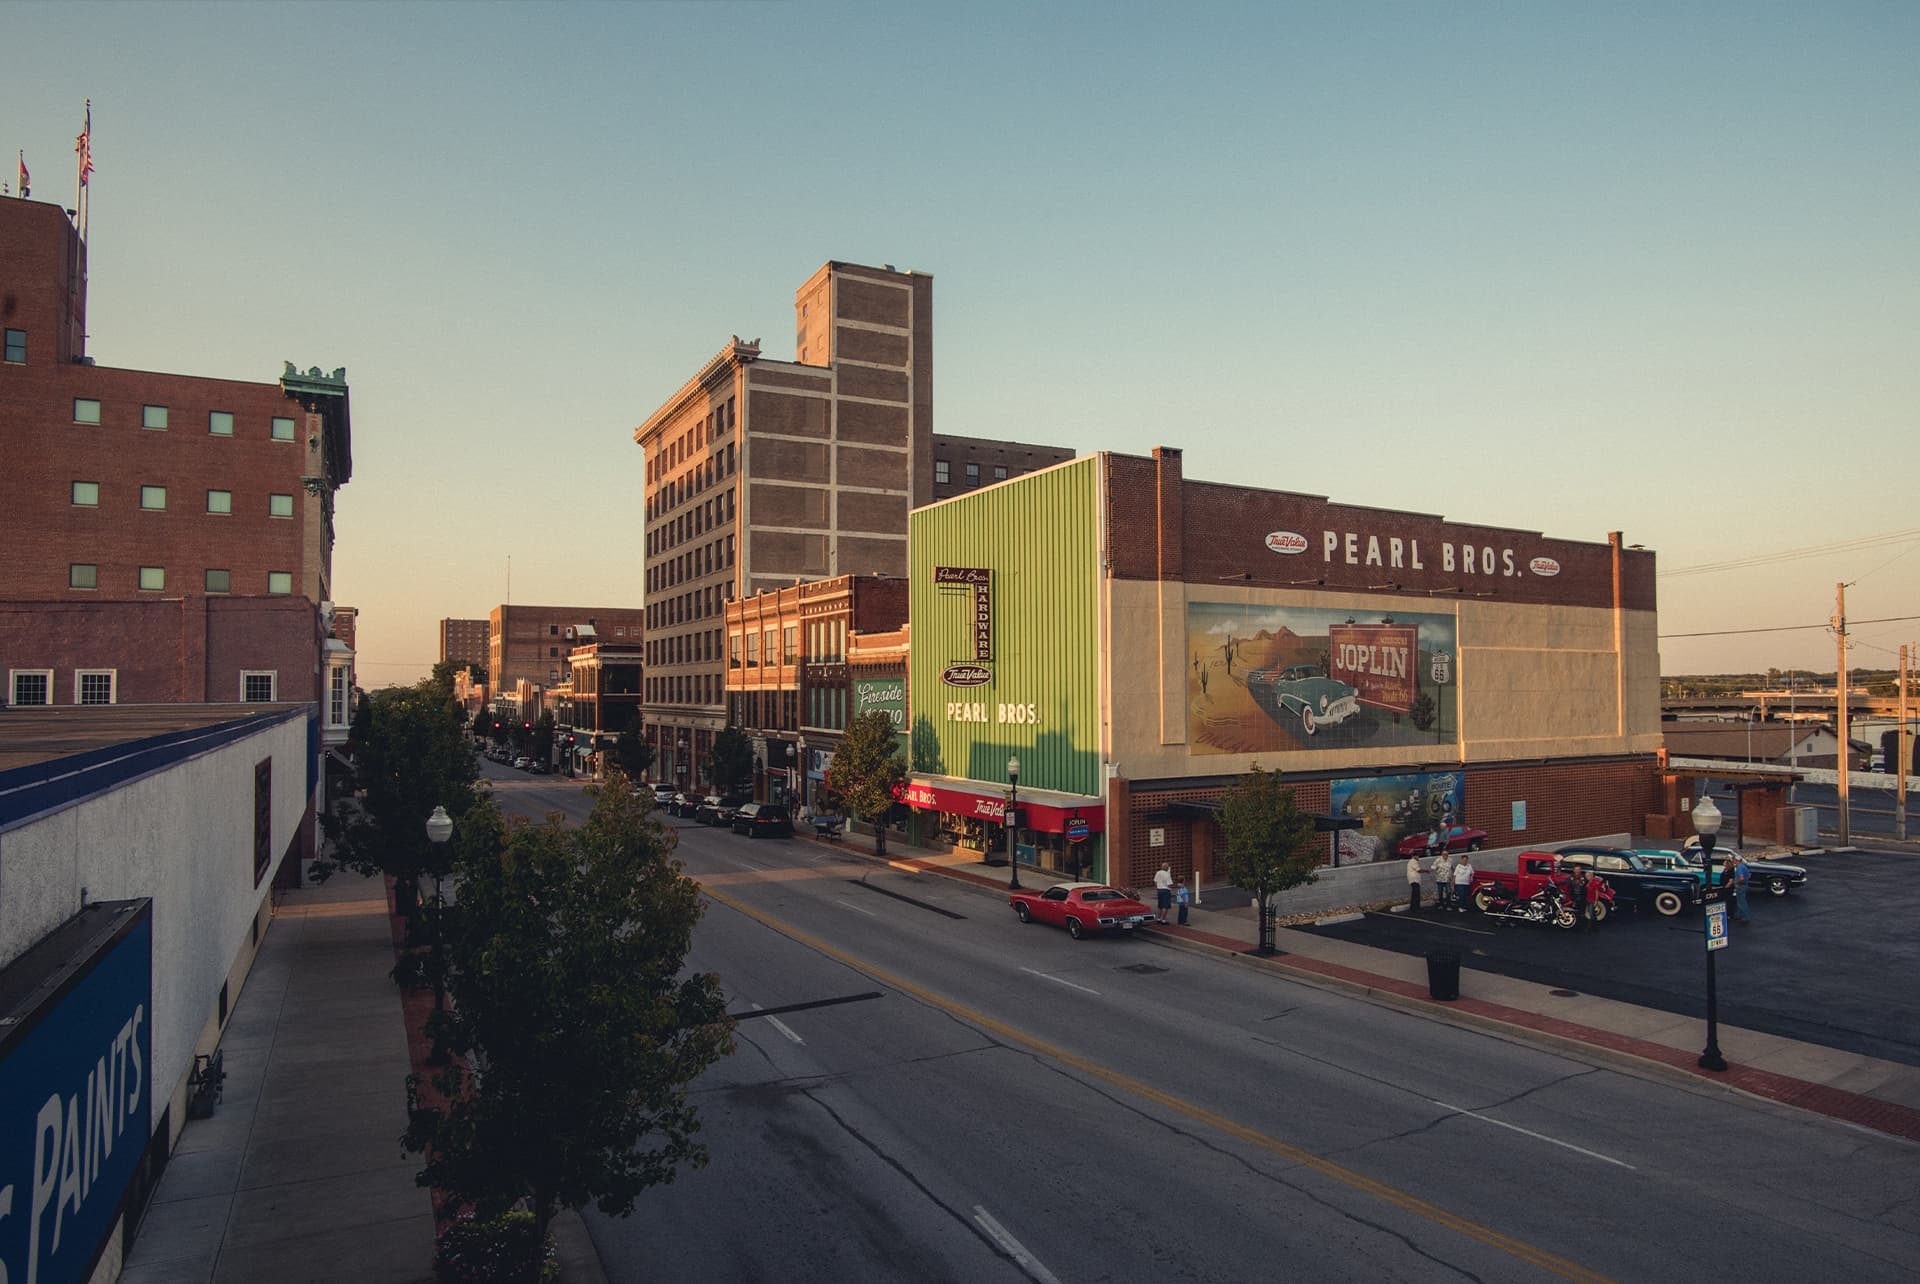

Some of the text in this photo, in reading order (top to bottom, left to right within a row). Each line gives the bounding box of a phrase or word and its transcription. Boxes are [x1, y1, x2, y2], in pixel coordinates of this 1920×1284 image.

[1323, 530, 1522, 577] PEARL BROS.
[937, 568, 965, 581] Pearl
[978, 585, 989, 658] HARDWARE
[1335, 643, 1408, 680] JOPLIN
[1434, 669, 1445, 681] 66
[857, 683, 903, 713] Fireside
[947, 702, 1041, 725] PEARL BROS.
[1431, 792, 1452, 812] 66
[1712, 925, 1721, 935] 66
[27, 1003, 144, 1284] PAINTS
